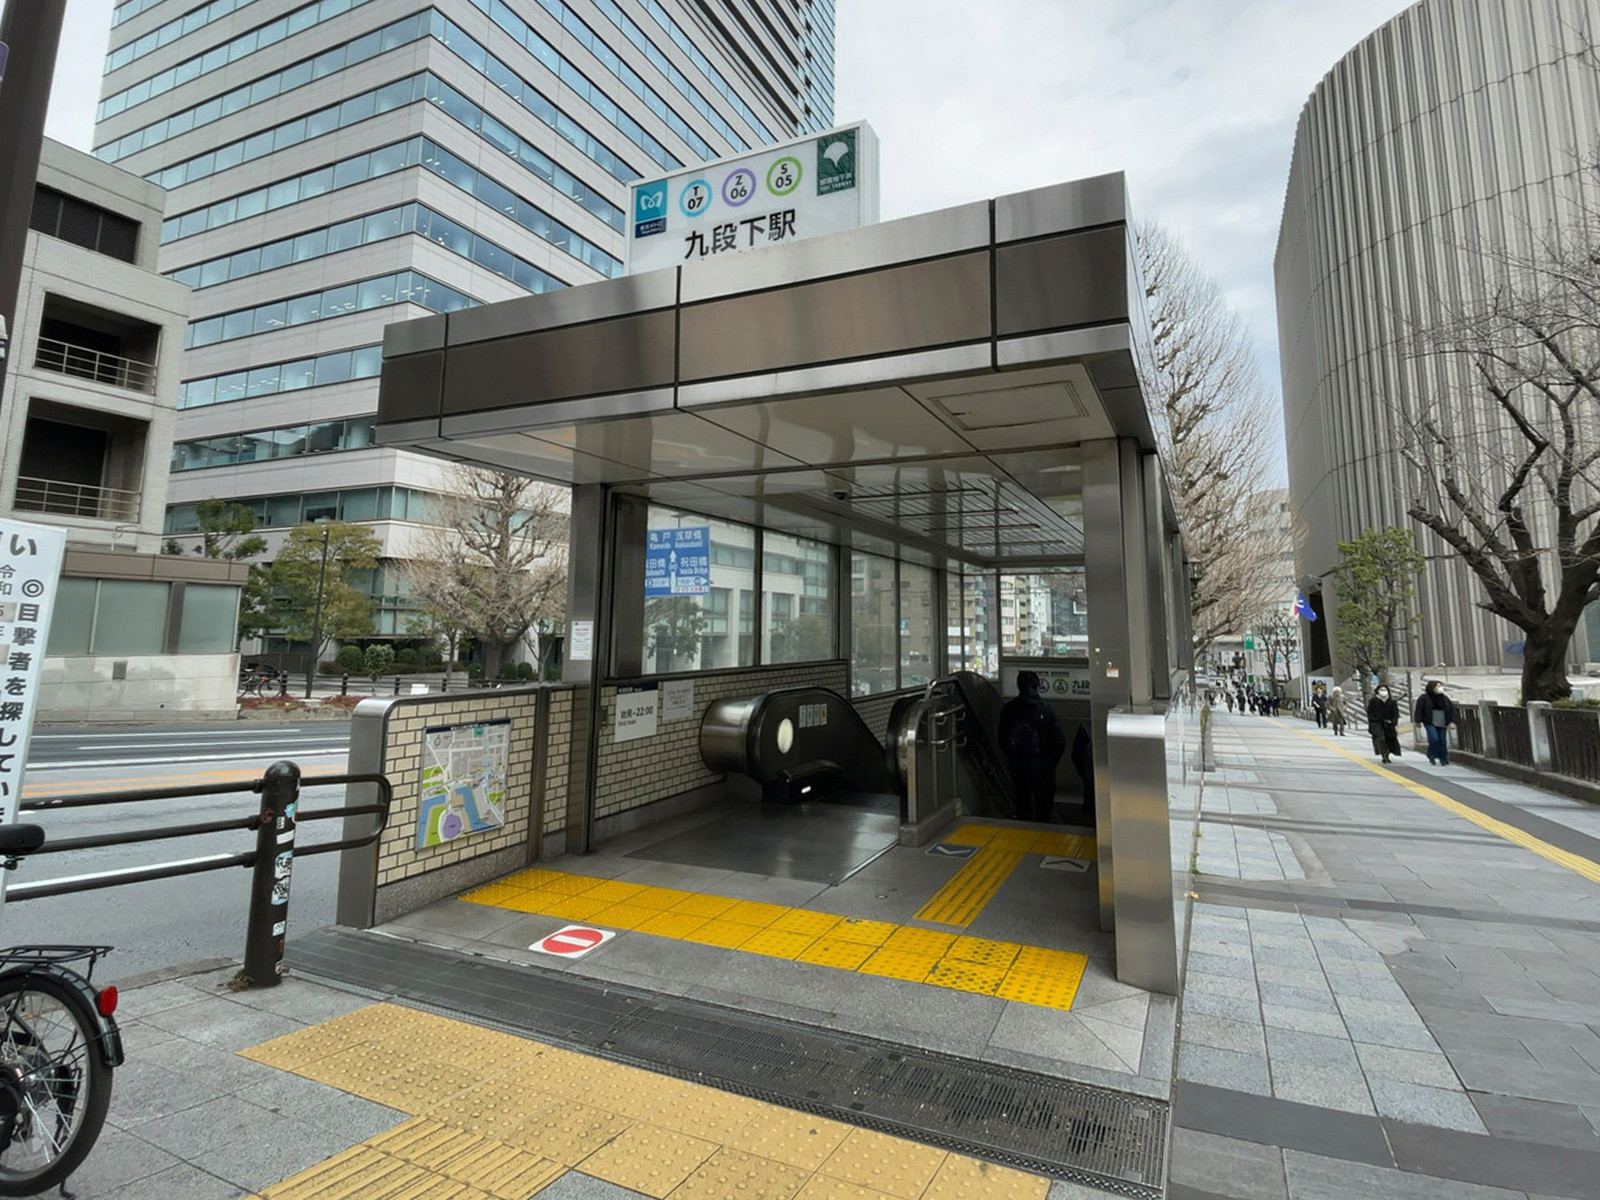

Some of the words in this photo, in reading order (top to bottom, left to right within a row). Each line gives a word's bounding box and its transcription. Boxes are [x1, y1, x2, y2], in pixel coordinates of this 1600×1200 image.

[781, 163, 788, 174] S
[735, 175, 743, 186] Z
[775, 175, 792, 188] 05
[693, 186, 699, 196] T
[730, 187, 747, 199] 06
[688, 196, 704, 210] 07
[685, 209, 796, 260] 九段下駅
